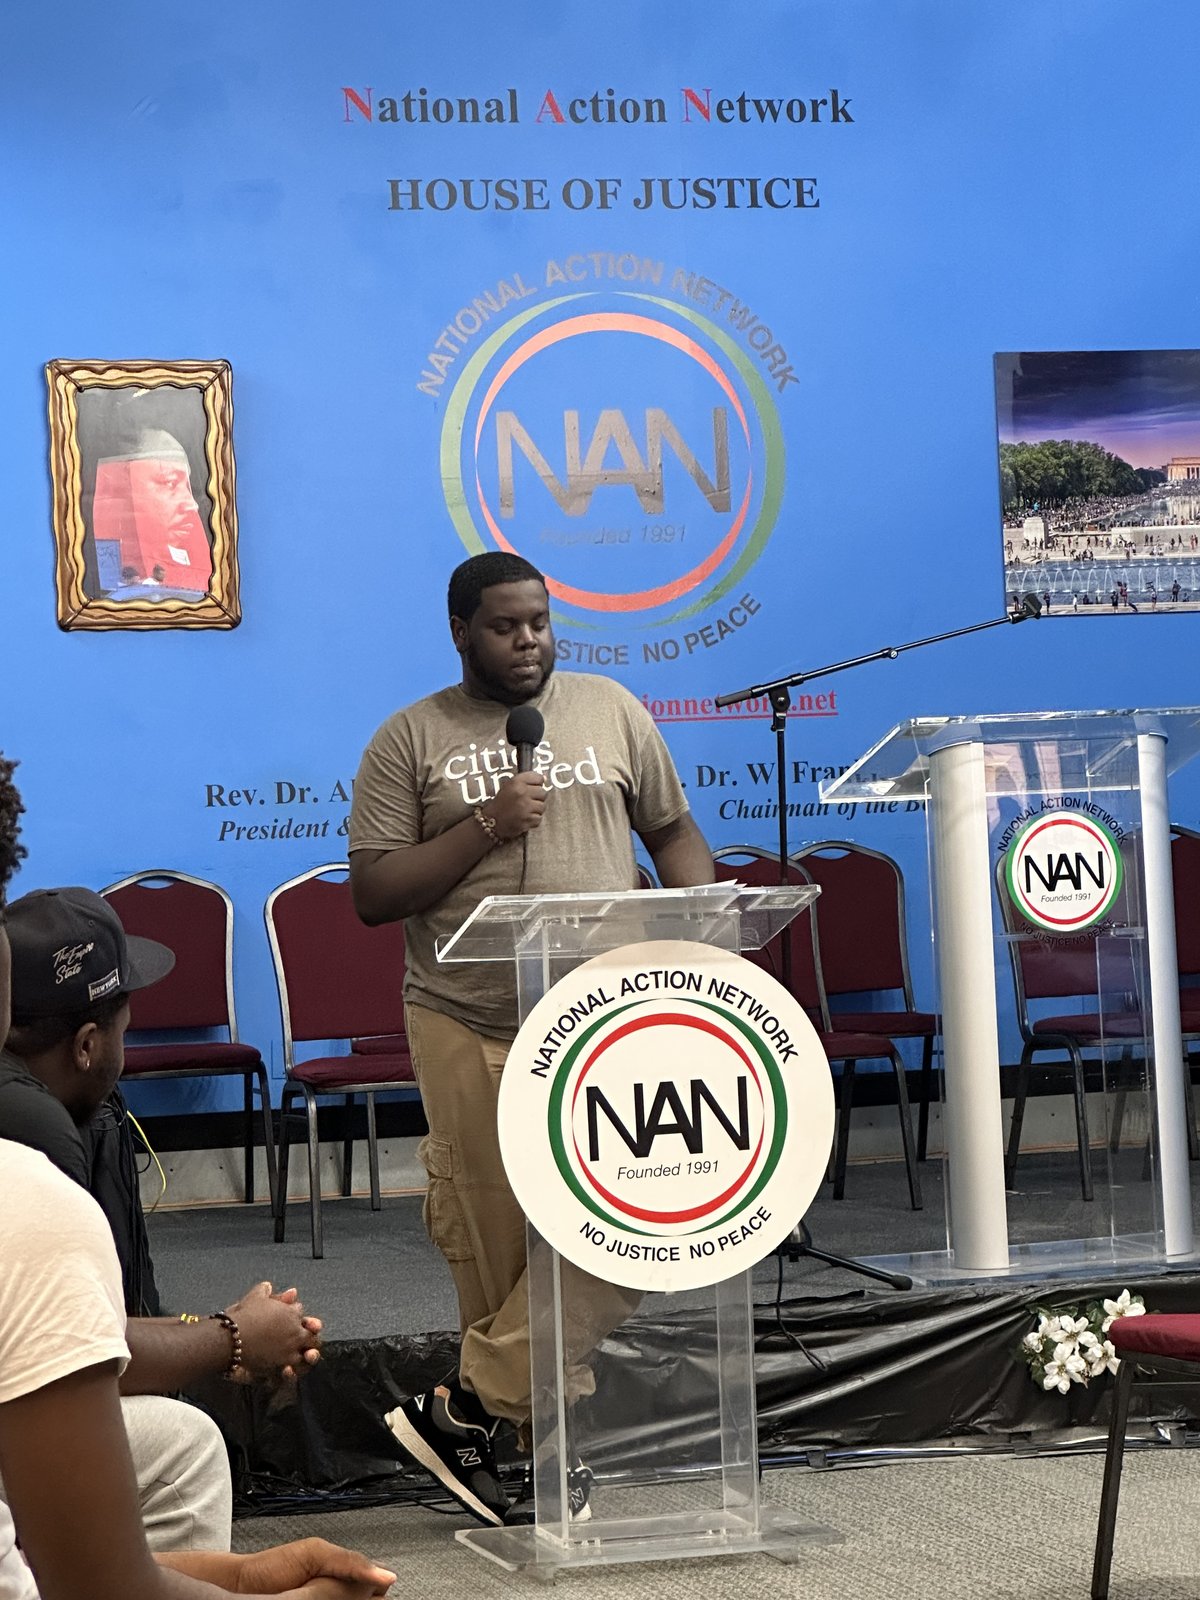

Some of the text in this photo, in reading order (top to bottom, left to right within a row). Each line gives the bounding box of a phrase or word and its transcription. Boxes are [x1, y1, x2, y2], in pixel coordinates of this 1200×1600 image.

[342, 87, 855, 123] National Action Network
[387, 177, 821, 211] HOUSE OF JUSTICE
[416, 252, 800, 398] NATIONAL ACTION NETWORK
[495, 406, 732, 519] NAN
[641, 524, 686, 544] 1991
[642, 639, 681, 664] NO
[683, 593, 763, 655] PEACE
[444, 739, 555, 780] citis
[458, 745, 606, 805] unted
[696, 765, 738, 788] Dr.
[204, 784, 265, 808] Rev.
[274, 781, 319, 805] Dr.
[217, 817, 330, 842] President
[997, 797, 1128, 852] NATIONAL ACTION NETWORK
[1024, 851, 1105, 893] NAN
[1040, 892, 1091, 903] Founded 1991
[1020, 922, 1033, 935] NO
[1033, 933, 1071, 946] JUSTICE
[1073, 936, 1086, 945] NO
[530, 970, 799, 1079] NATIONAL ACTION NETWORK
[585, 1076, 751, 1162] NAN
[617, 1160, 720, 1180] Founded 1991
[579, 1206, 772, 1262] NO JUSTICE NO PEACE
